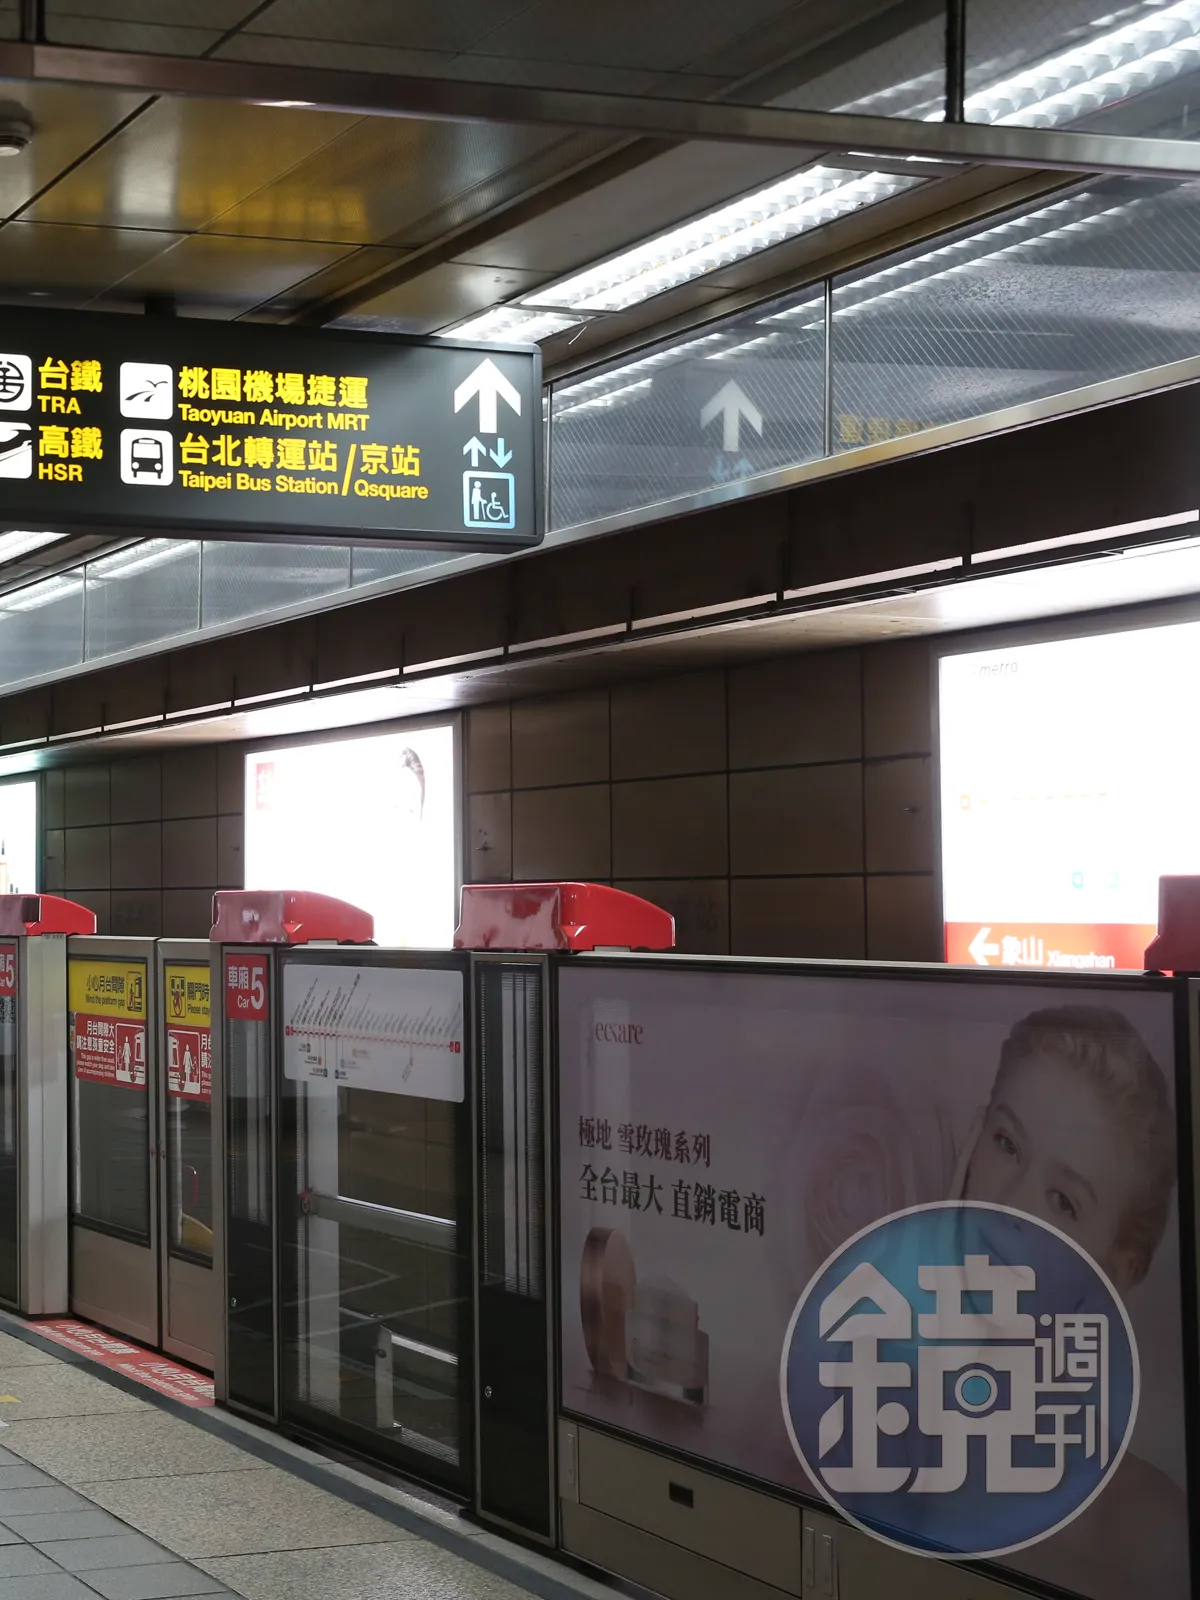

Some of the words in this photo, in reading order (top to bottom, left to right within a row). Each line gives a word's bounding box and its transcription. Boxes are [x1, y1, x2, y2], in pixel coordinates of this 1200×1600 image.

[38, 357, 103, 394] 台鐵
[178, 366, 369, 409] 桃園機場捷運
[38, 395, 81, 416] TRA
[178, 403, 255, 429] Taoyuan
[259, 409, 321, 431] Airport
[327, 412, 370, 432] MRT
[38, 426, 103, 461] 高鐵
[38, 463, 84, 483] HSR
[179, 469, 233, 492] Taipei
[236, 475, 272, 492] Bus
[275, 476, 339, 496] Station
[353, 478, 429, 502] Qsquare
[1001, 934, 1044, 966] 象山
[6, 953, 15, 988] 5
[86, 974, 125, 994] 小心月台間隙
[227, 965, 249, 991] 車廂
[251, 966, 265, 1010] 5
[237, 994, 250, 1009] Car
